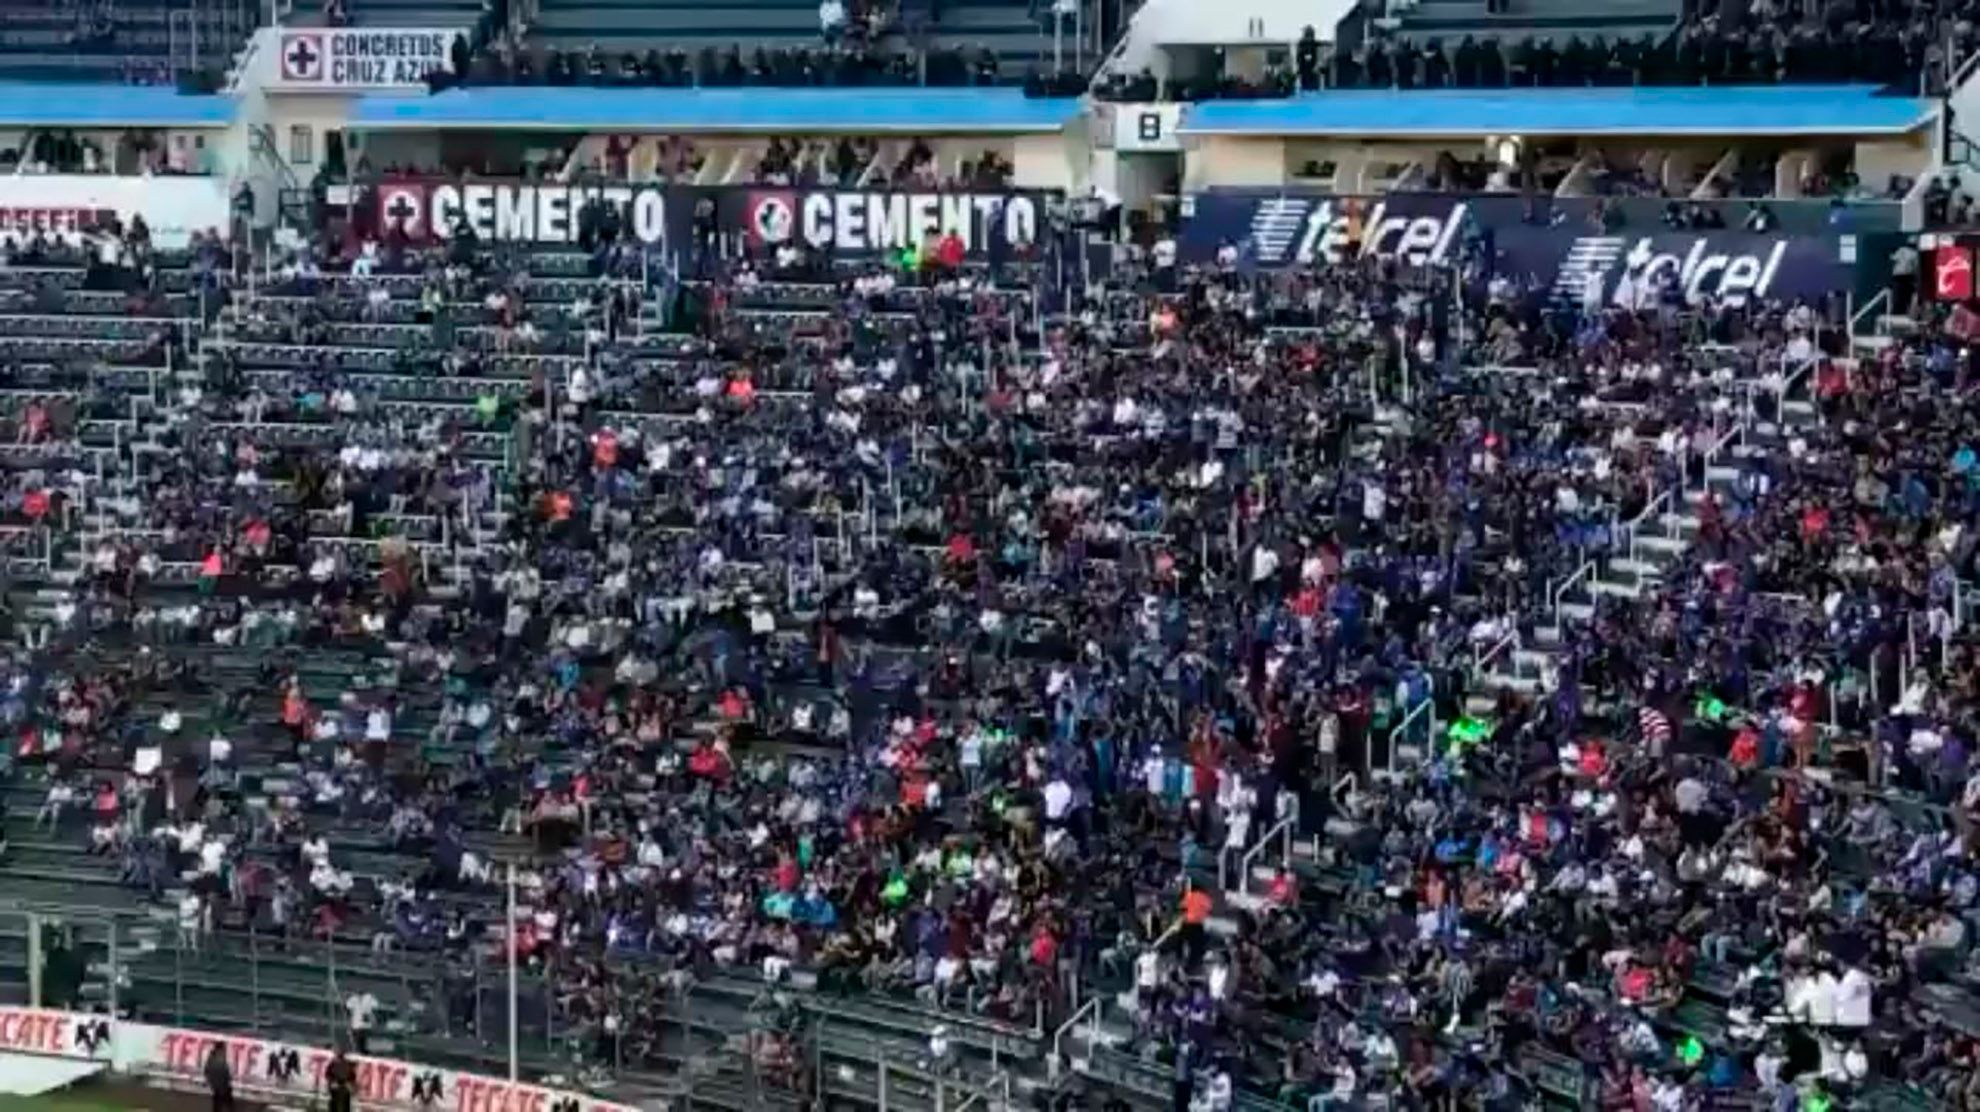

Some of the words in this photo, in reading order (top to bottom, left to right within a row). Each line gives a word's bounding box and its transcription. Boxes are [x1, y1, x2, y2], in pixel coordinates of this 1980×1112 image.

[332, 33, 443, 57] CONCRETOS
[332, 58, 386, 83] CRUZ
[1138, 113, 1161, 141] B
[803, 192, 1036, 252] CEMENTO
[162, 1034, 265, 1078] TECTE
[309, 1055, 408, 1101] TATE
